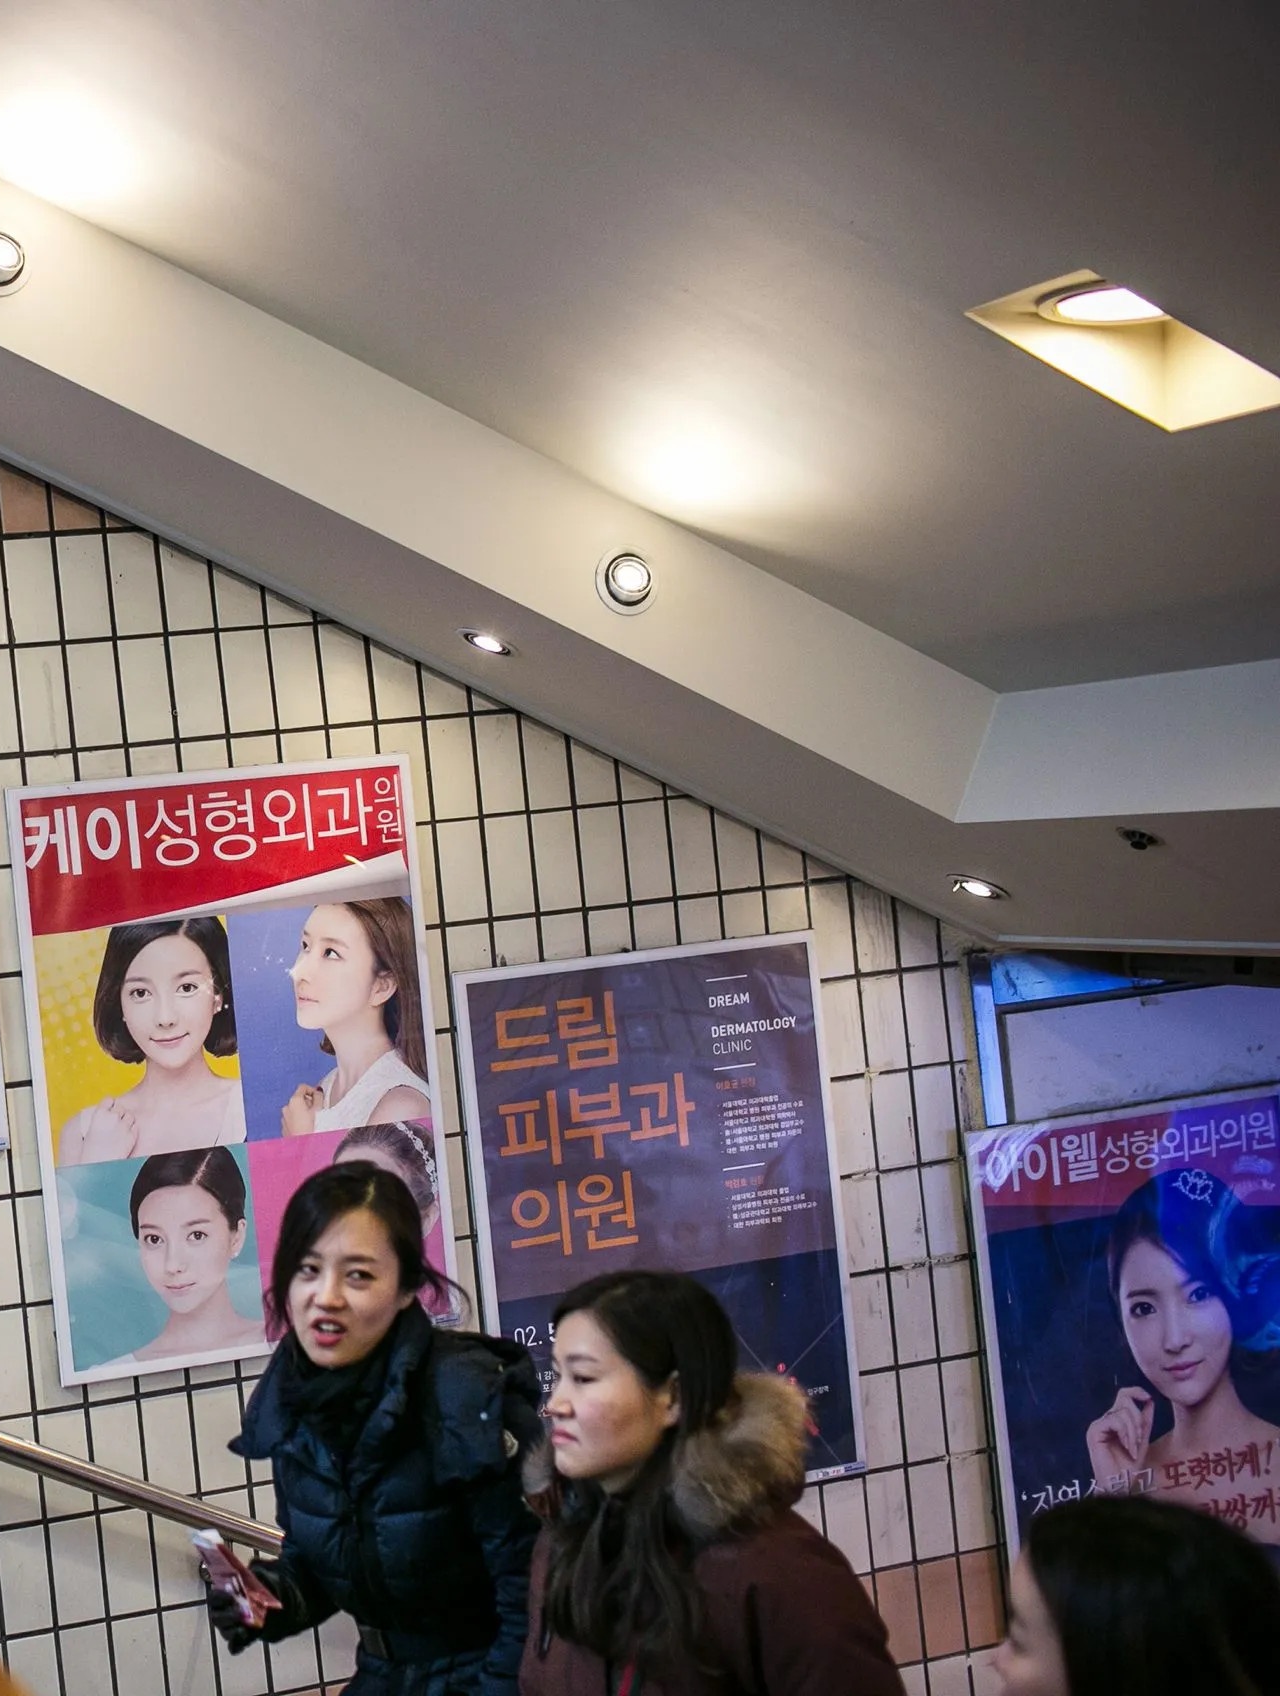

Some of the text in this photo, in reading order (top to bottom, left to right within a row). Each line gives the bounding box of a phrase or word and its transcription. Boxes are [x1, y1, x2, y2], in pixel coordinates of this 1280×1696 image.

[708, 992, 750, 1008] DREAM
[490, 990, 618, 1072] 드림
[711, 1016, 796, 1038] DERMATOLOGY
[712, 1039, 752, 1055] CLINIC
[498, 1072, 695, 1166] 피부과
[511, 1171, 638, 1256] 의원
[1162, 1440, 1273, 1490] 또렷하게!
